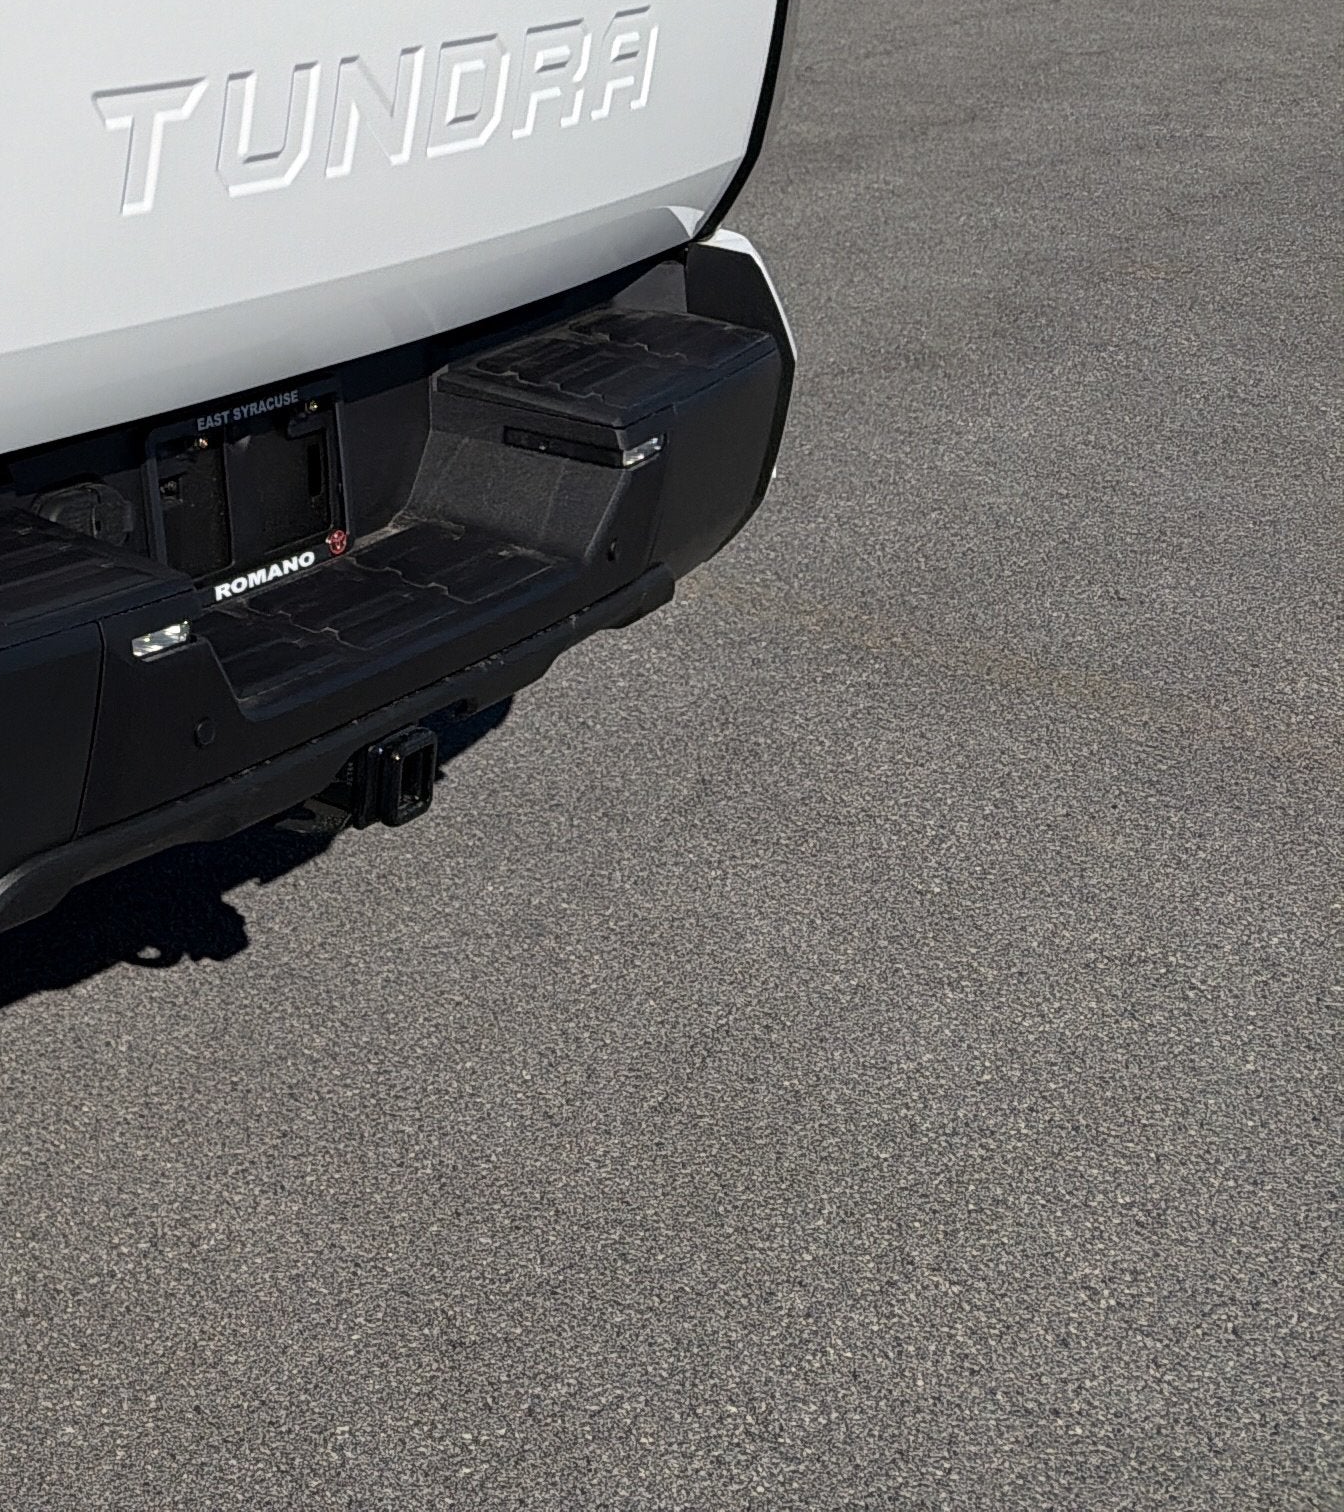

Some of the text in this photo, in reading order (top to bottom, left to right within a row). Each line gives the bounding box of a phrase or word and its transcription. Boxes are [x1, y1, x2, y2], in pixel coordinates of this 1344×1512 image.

[91, 4, 659, 217] TUNDRA
[196, 390, 299, 431] EAST SYRACUSE
[214, 550, 316, 602] ROMANO
